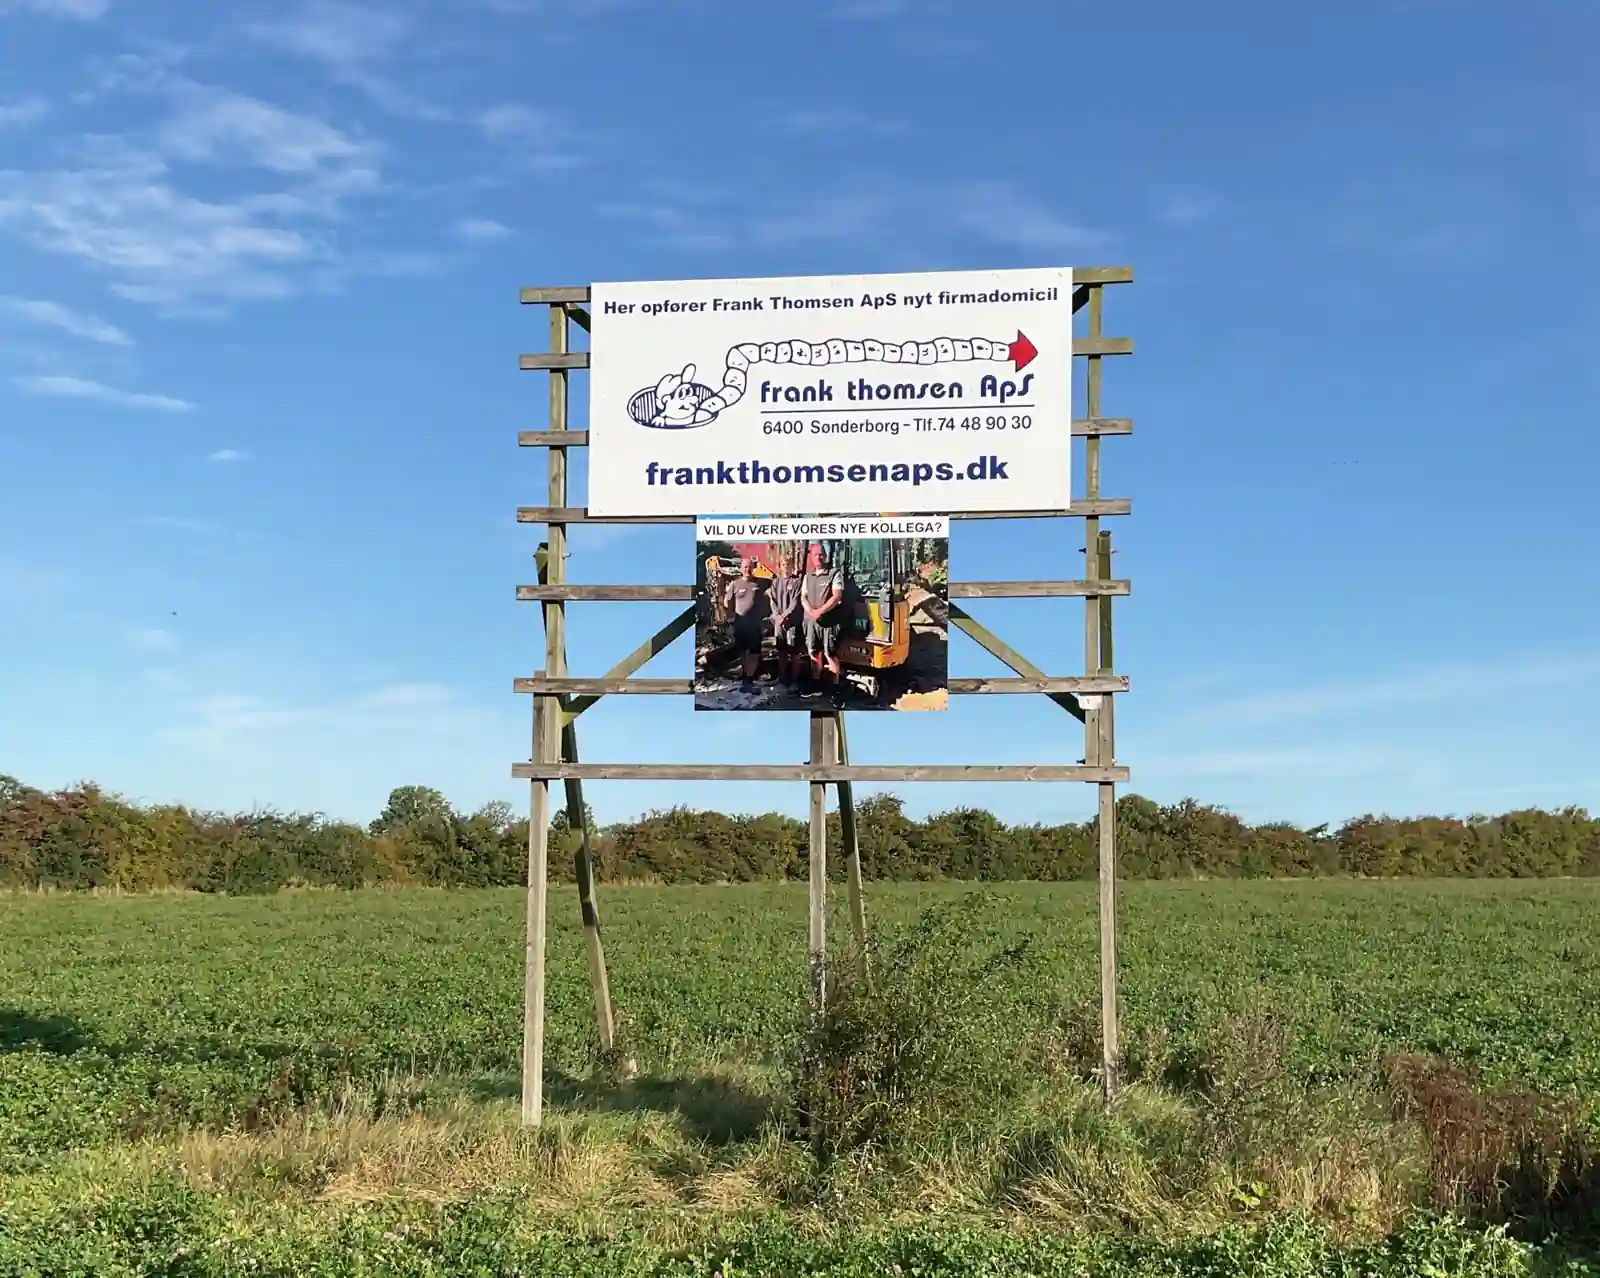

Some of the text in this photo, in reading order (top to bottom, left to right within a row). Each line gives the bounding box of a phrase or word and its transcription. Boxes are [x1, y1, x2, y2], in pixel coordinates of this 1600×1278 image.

[604, 287, 1058, 317] Her opfører Frank Thomsen ApS nyt firmadomicil
[760, 374, 1035, 404] frank thomsen ApS
[762, 420, 804, 435] 6400
[810, 419, 900, 436] Sønderborg
[960, 416, 981, 431] 48
[985, 415, 1007, 430] 90
[1011, 414, 1032, 430] 30
[645, 455, 1009, 487] frankthomsenaps.dk
[703, 522, 942, 536] VIL DU VÆRE VORES NYE KOLLEGA?
